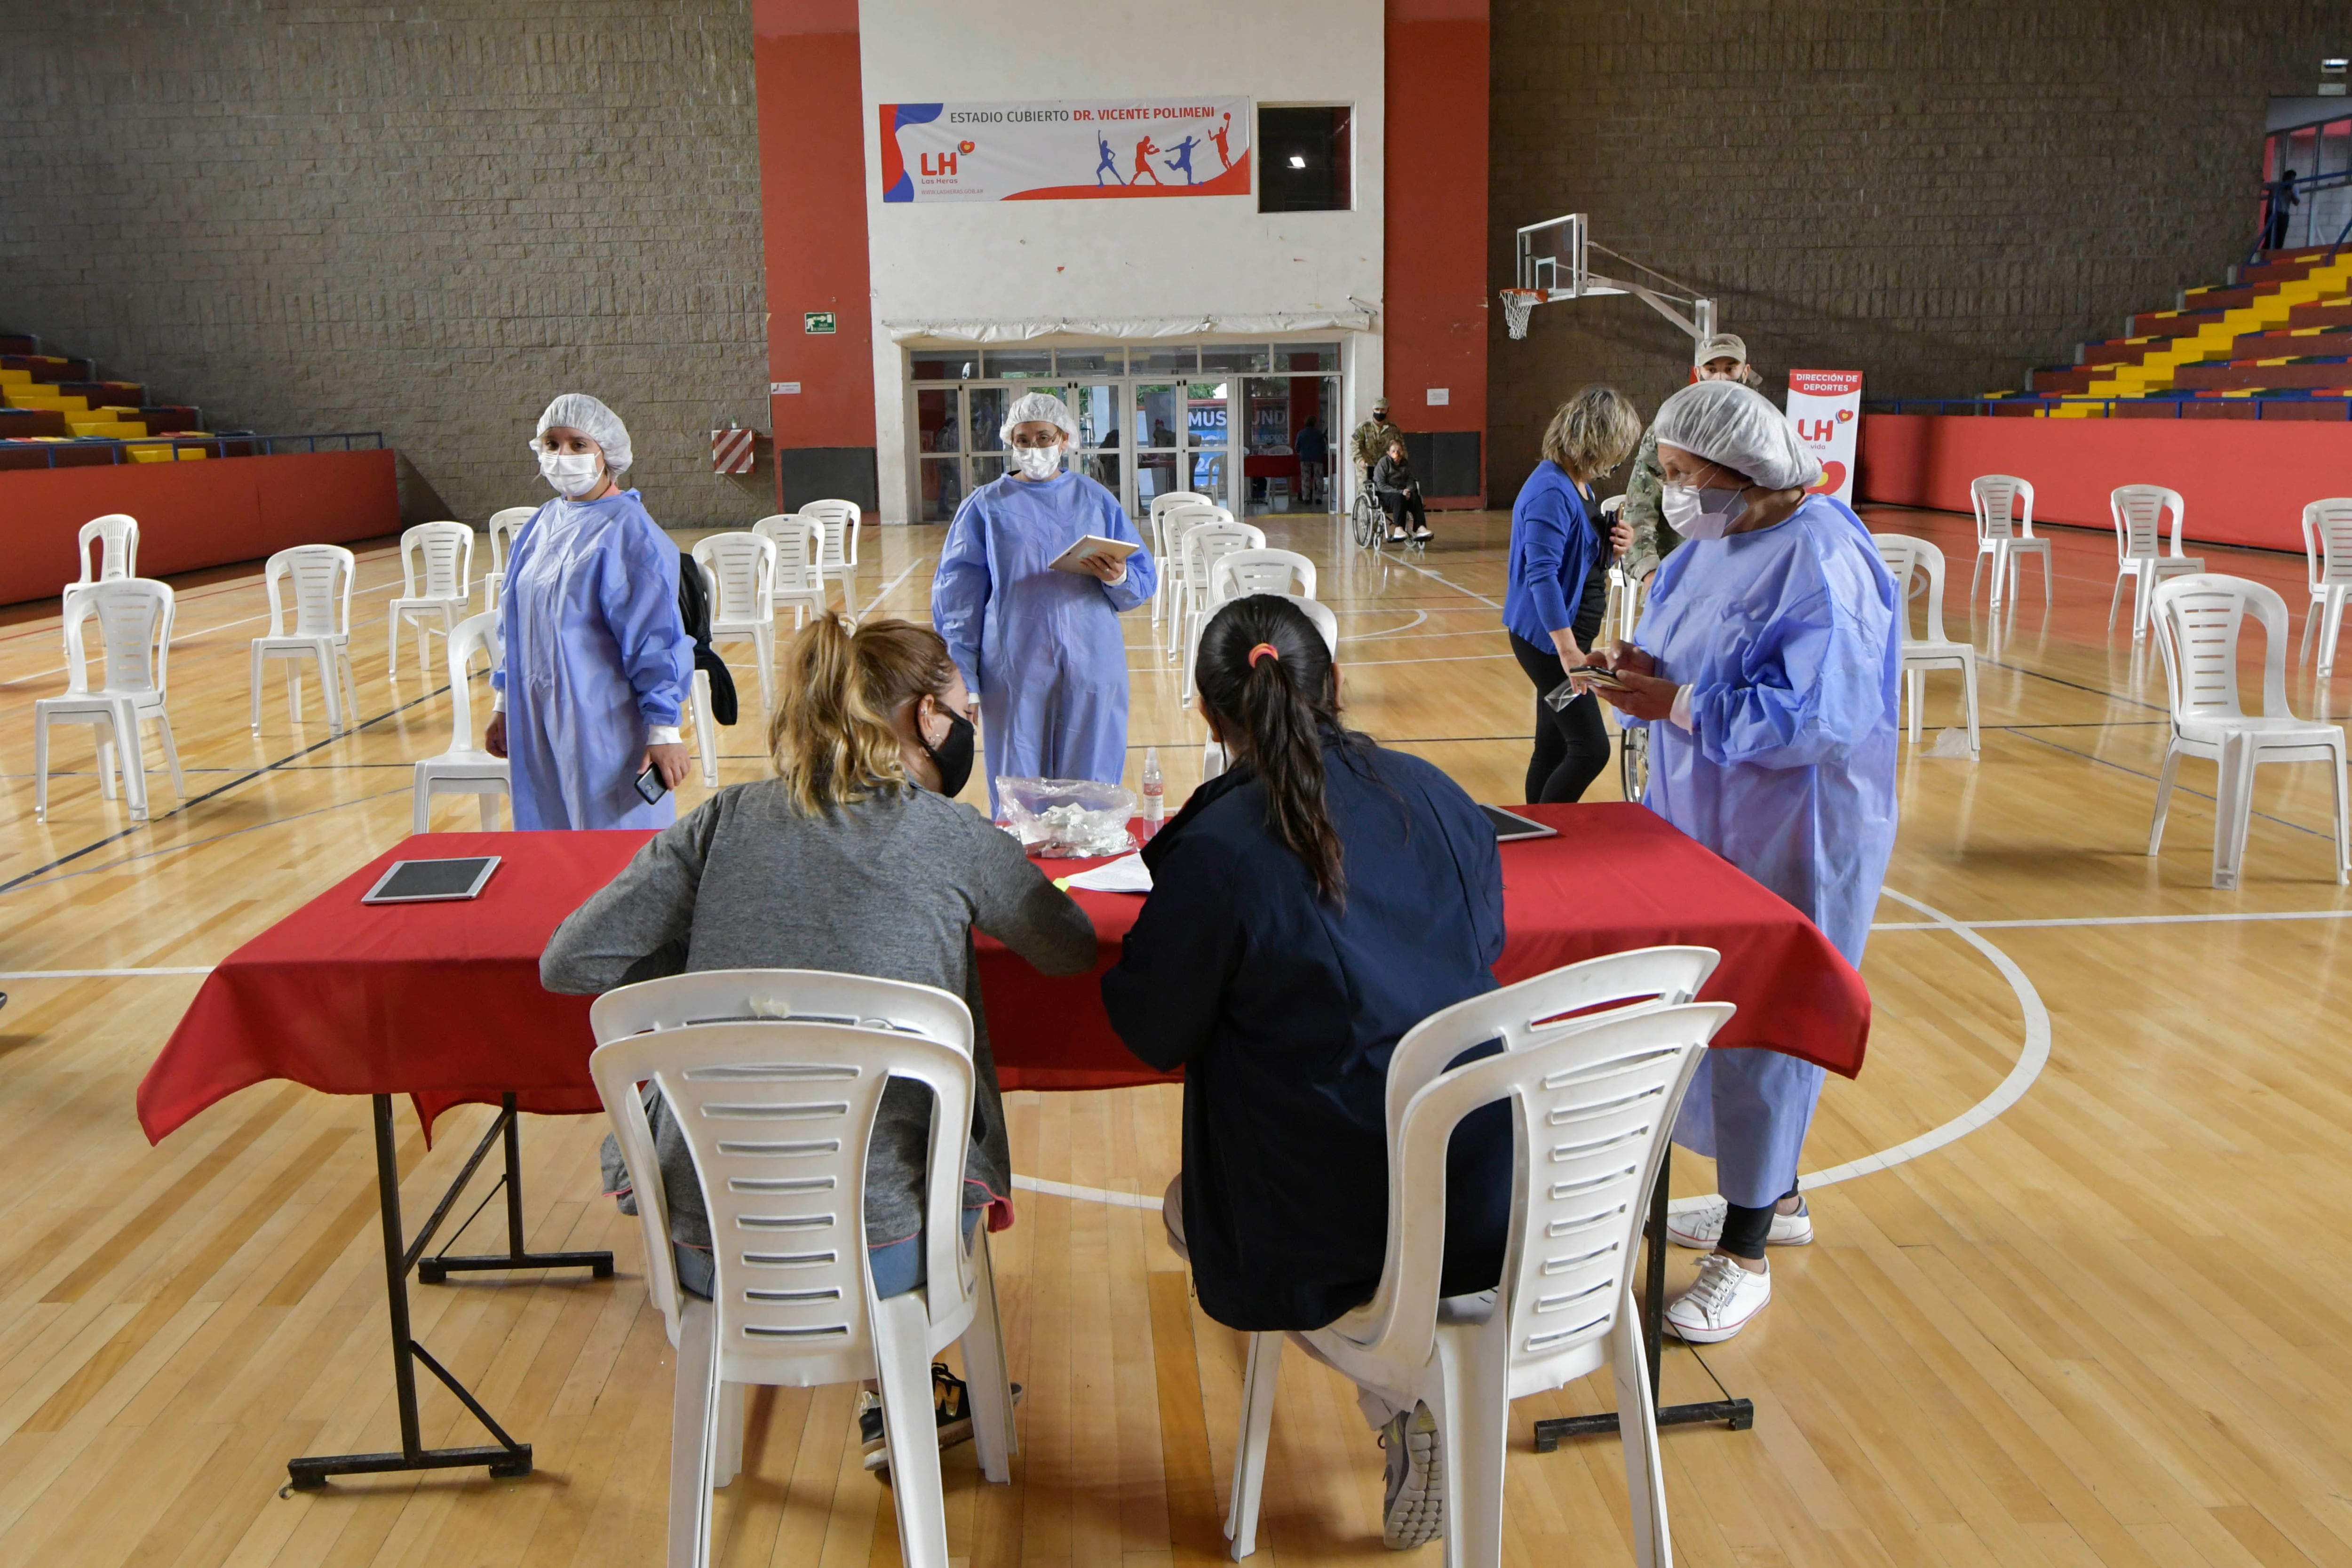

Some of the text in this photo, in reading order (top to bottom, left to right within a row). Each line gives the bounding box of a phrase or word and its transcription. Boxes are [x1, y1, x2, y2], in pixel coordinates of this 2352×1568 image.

[950, 106, 1215, 123] ESTADIO CUBIERTO DR. VICENTE POLIMENI
[921, 152, 957, 176] LH
[1796, 373, 1843, 382] DIRECCIÓN
[1798, 419, 1834, 442] LH
